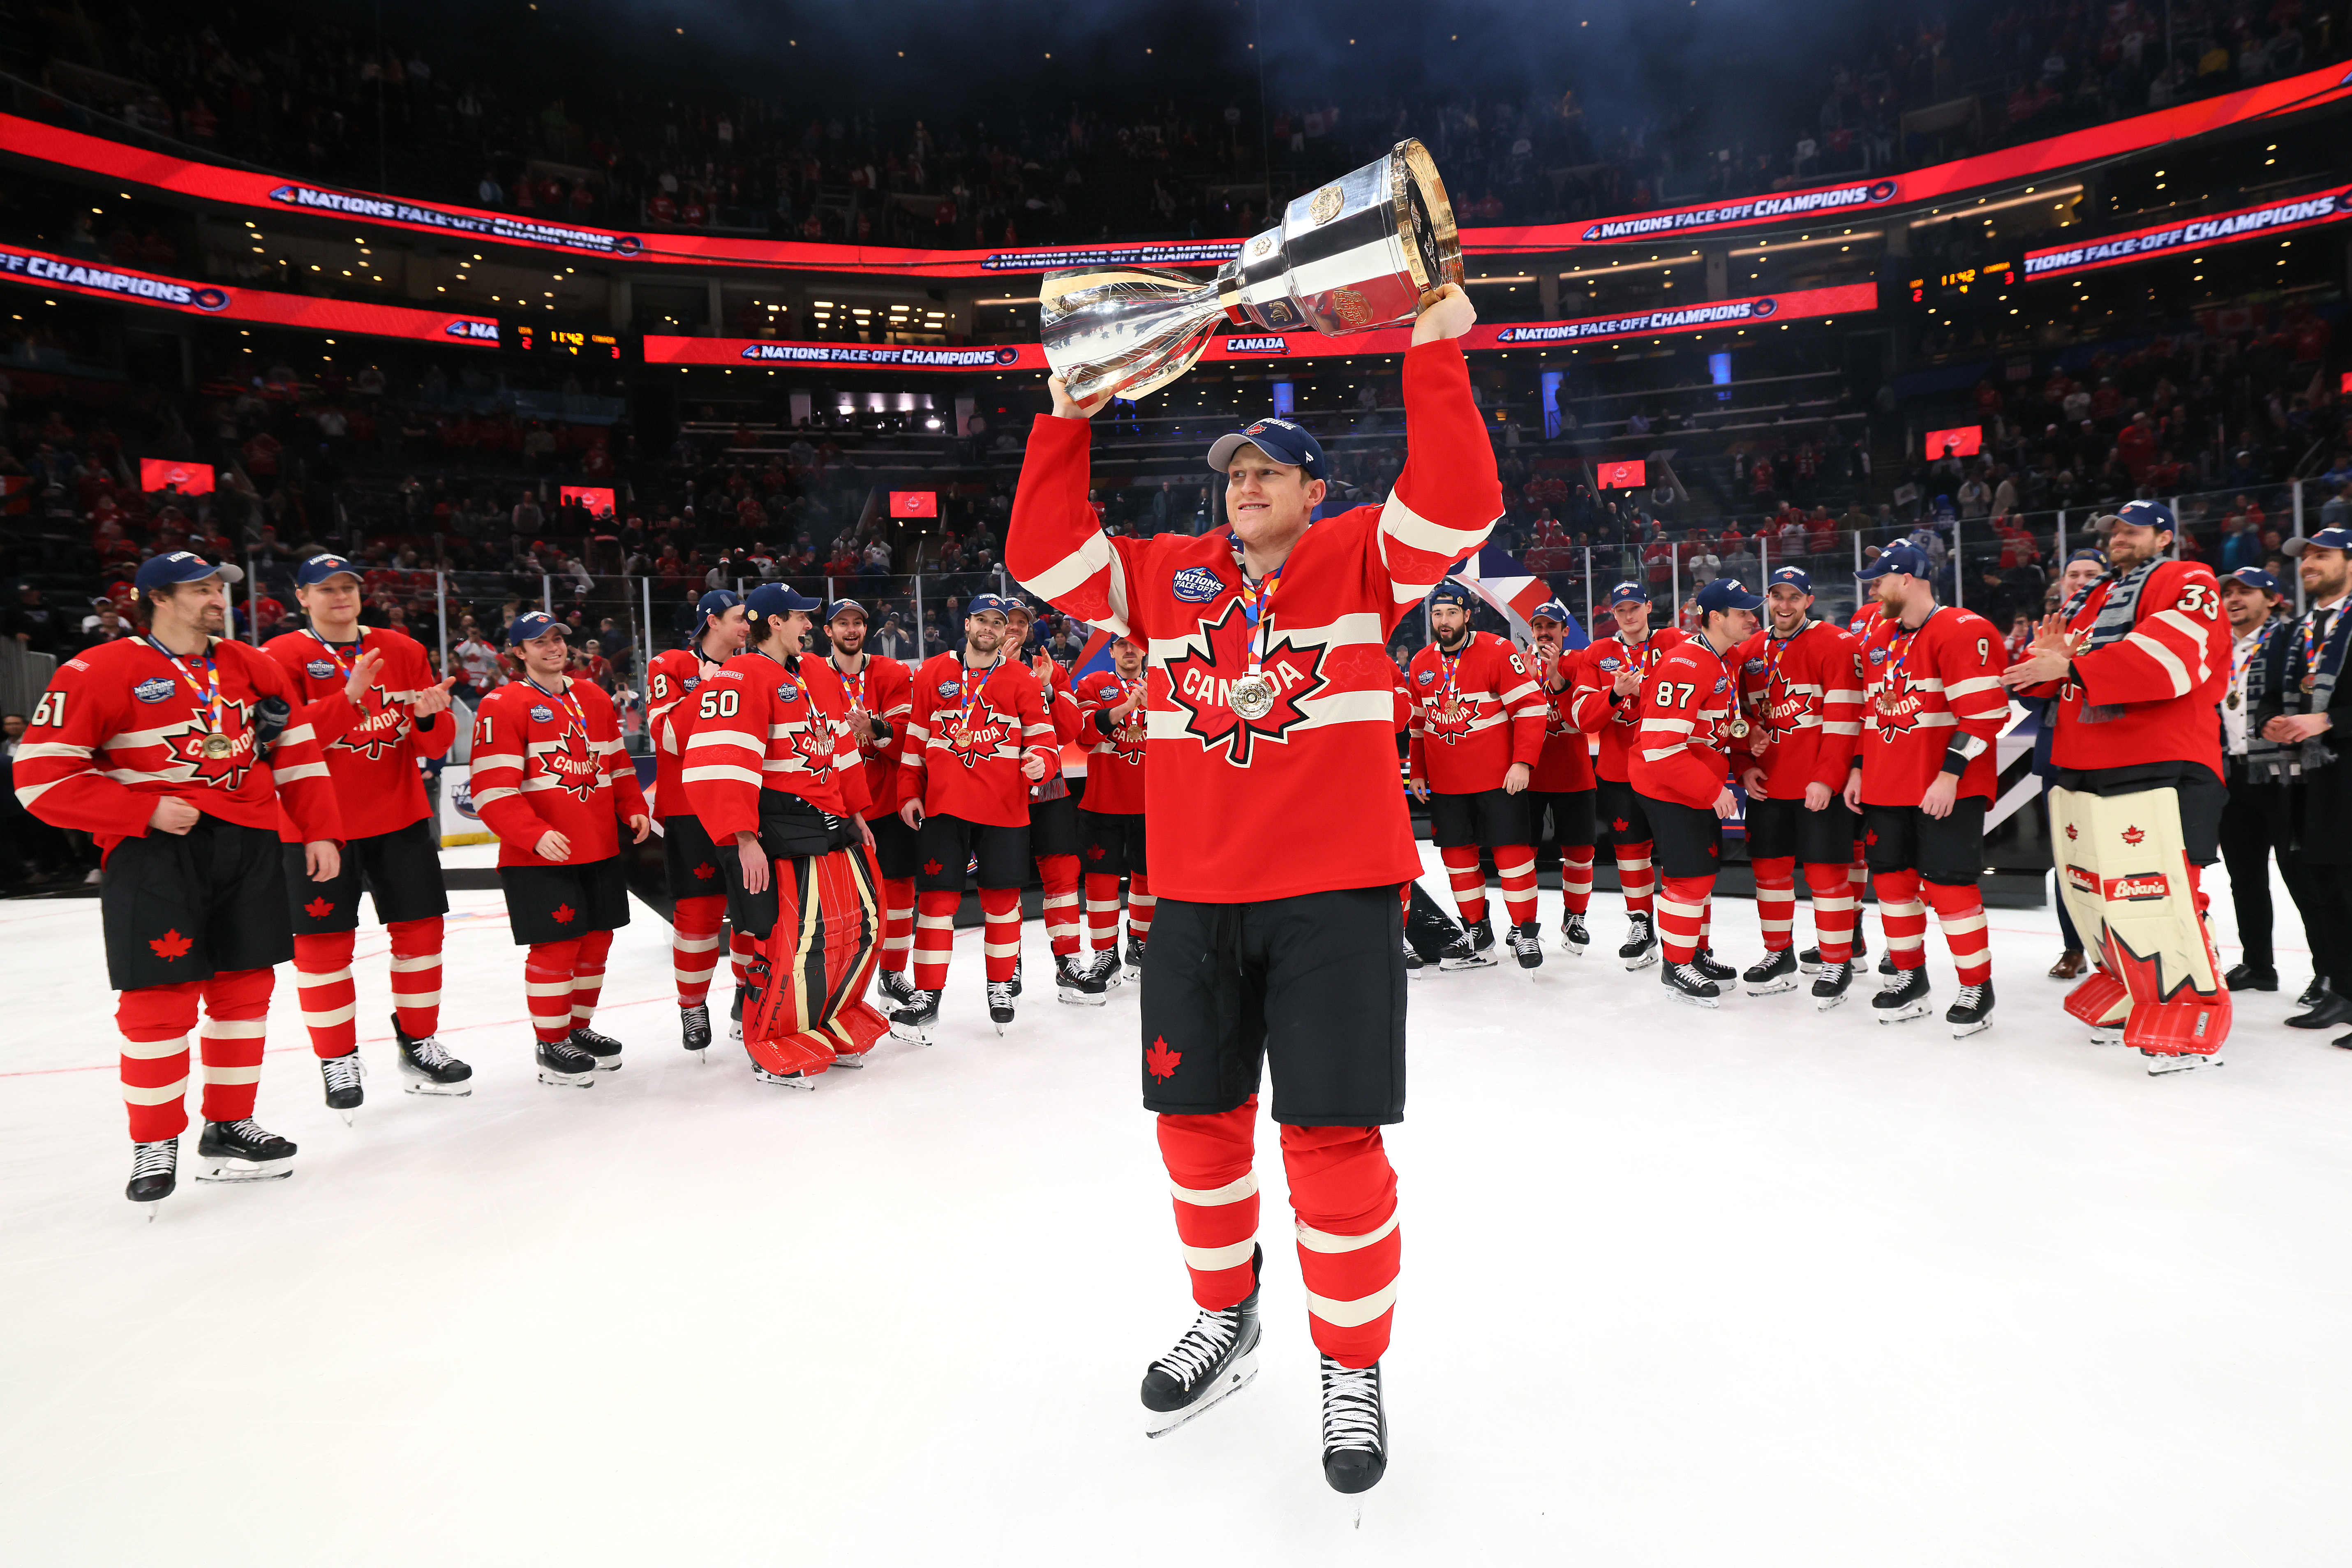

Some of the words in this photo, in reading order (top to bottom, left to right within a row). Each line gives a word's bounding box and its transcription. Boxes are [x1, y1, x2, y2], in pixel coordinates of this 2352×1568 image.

[297, 188, 395, 218] NATIONS
[1601, 215, 1673, 237] NATIONS
[1673, 204, 1751, 228] FACE-OFF
[1754, 186, 1867, 217] CHAMPIONS
[2083, 228, 2184, 263] FACE-OFF
[2184, 196, 2336, 240] CHAMPIONS
[1000, 252, 1068, 268] NATIONS
[1141, 243, 1241, 262] CHAMPIONS
[27, 255, 192, 303] CHAMPIONS
[2005, 271, 2015, 285] 3
[1913, 289, 1923, 303] 2
[1515, 324, 1579, 340] NATIONS
[1579, 315, 1649, 336] FACE-OFF
[1651, 302, 1751, 328] CHAMPIONS
[522, 336, 532, 350] 2
[569, 346, 578, 355] 4
[611, 346, 620, 359] 3
[761, 345, 829, 360] NATIONS
[831, 349, 901, 362] FACE-OFF
[902, 349, 996, 365] CHAMPIONS
[1227, 337, 1285, 351] CANADA
[1174, 570, 1225, 591] NATIONS
[1176, 580, 1215, 593] FACE-OFF
[2176, 584, 2220, 621] 33
[1509, 653, 1526, 675] 8
[1652, 648, 1663, 667] A
[1677, 658, 1696, 667] ROGERS
[1976, 637, 1989, 666] 9
[1853, 653, 1864, 679] 5
[134, 680, 176, 694] NATIONS
[645, 672, 668, 705] 48
[1656, 681, 1695, 709] 87
[31, 691, 68, 728] 61
[699, 689, 740, 720] 50
[474, 716, 493, 747] 21
[1673, 979, 1688, 989] CCM
[766, 974, 789, 1037] TRUE
[1215, 1340, 1240, 1374] CCM
